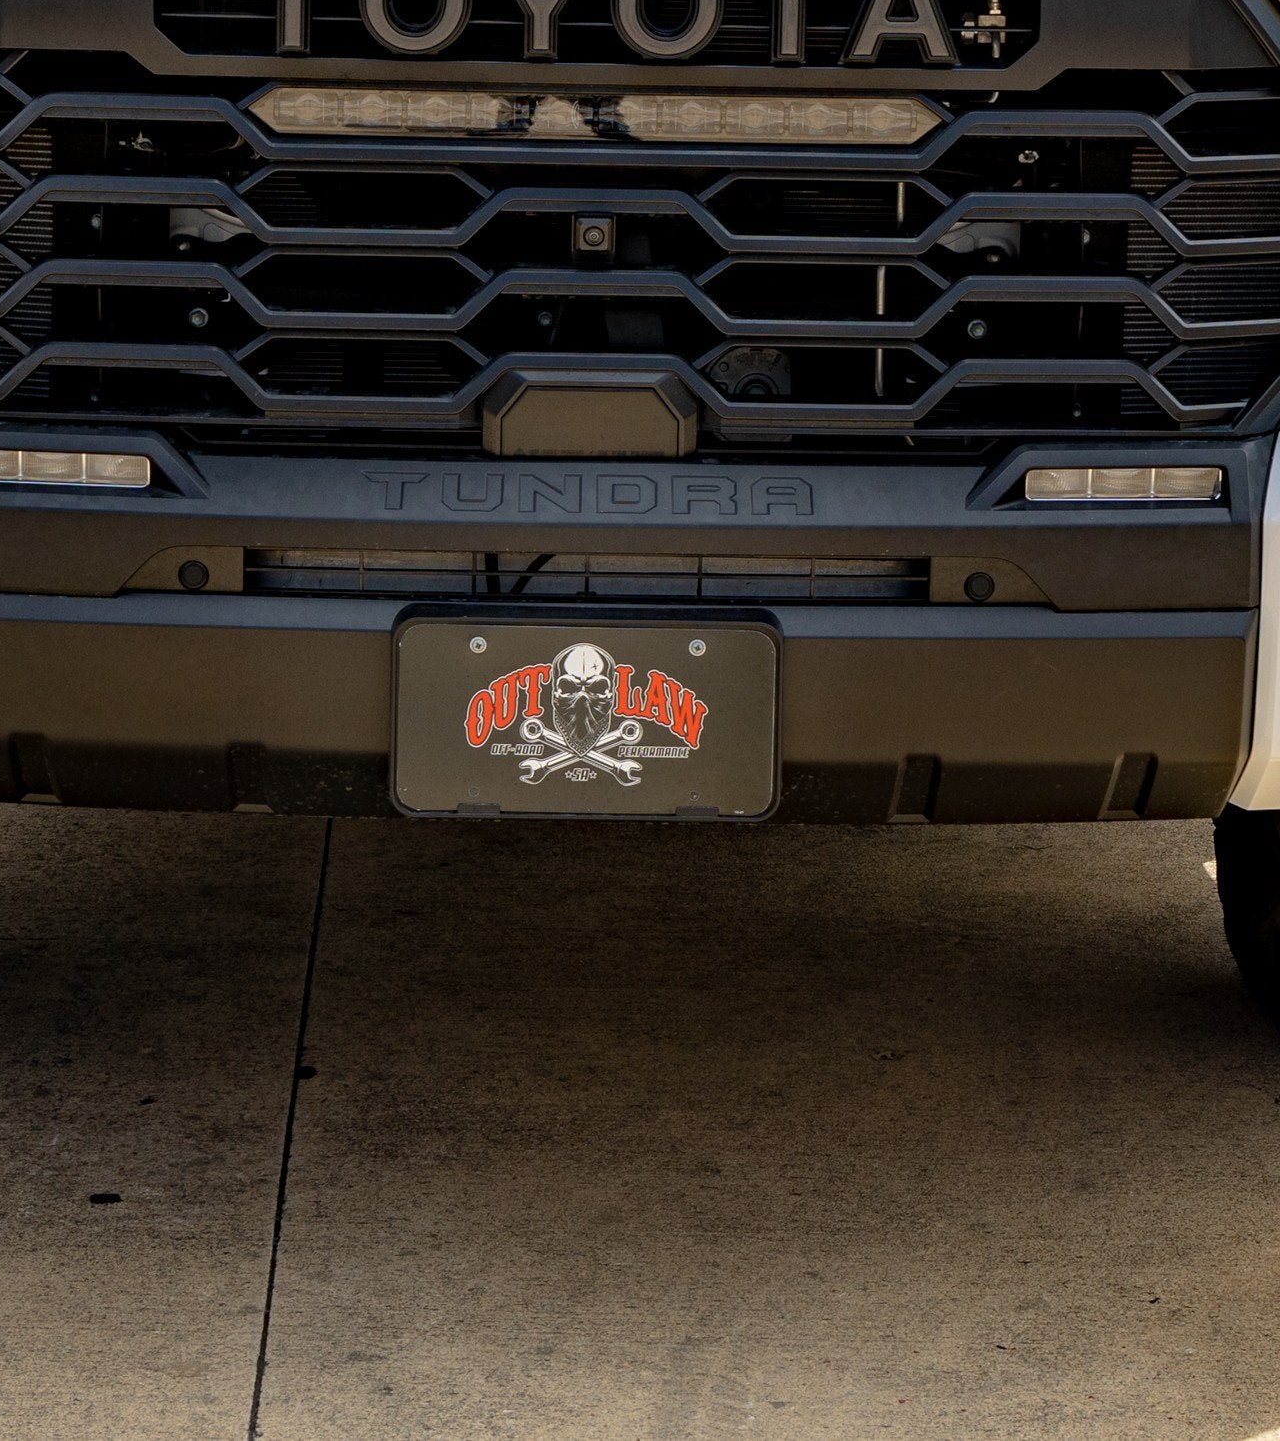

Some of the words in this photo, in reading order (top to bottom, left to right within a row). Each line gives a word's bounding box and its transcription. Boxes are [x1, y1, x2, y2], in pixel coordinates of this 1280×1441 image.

[361, 469, 815, 517] TUNDRA
[490, 743, 544, 756] OFF-ROAD
[617, 745, 690, 758] PERFORMANCE
[571, 767, 591, 782] SA
